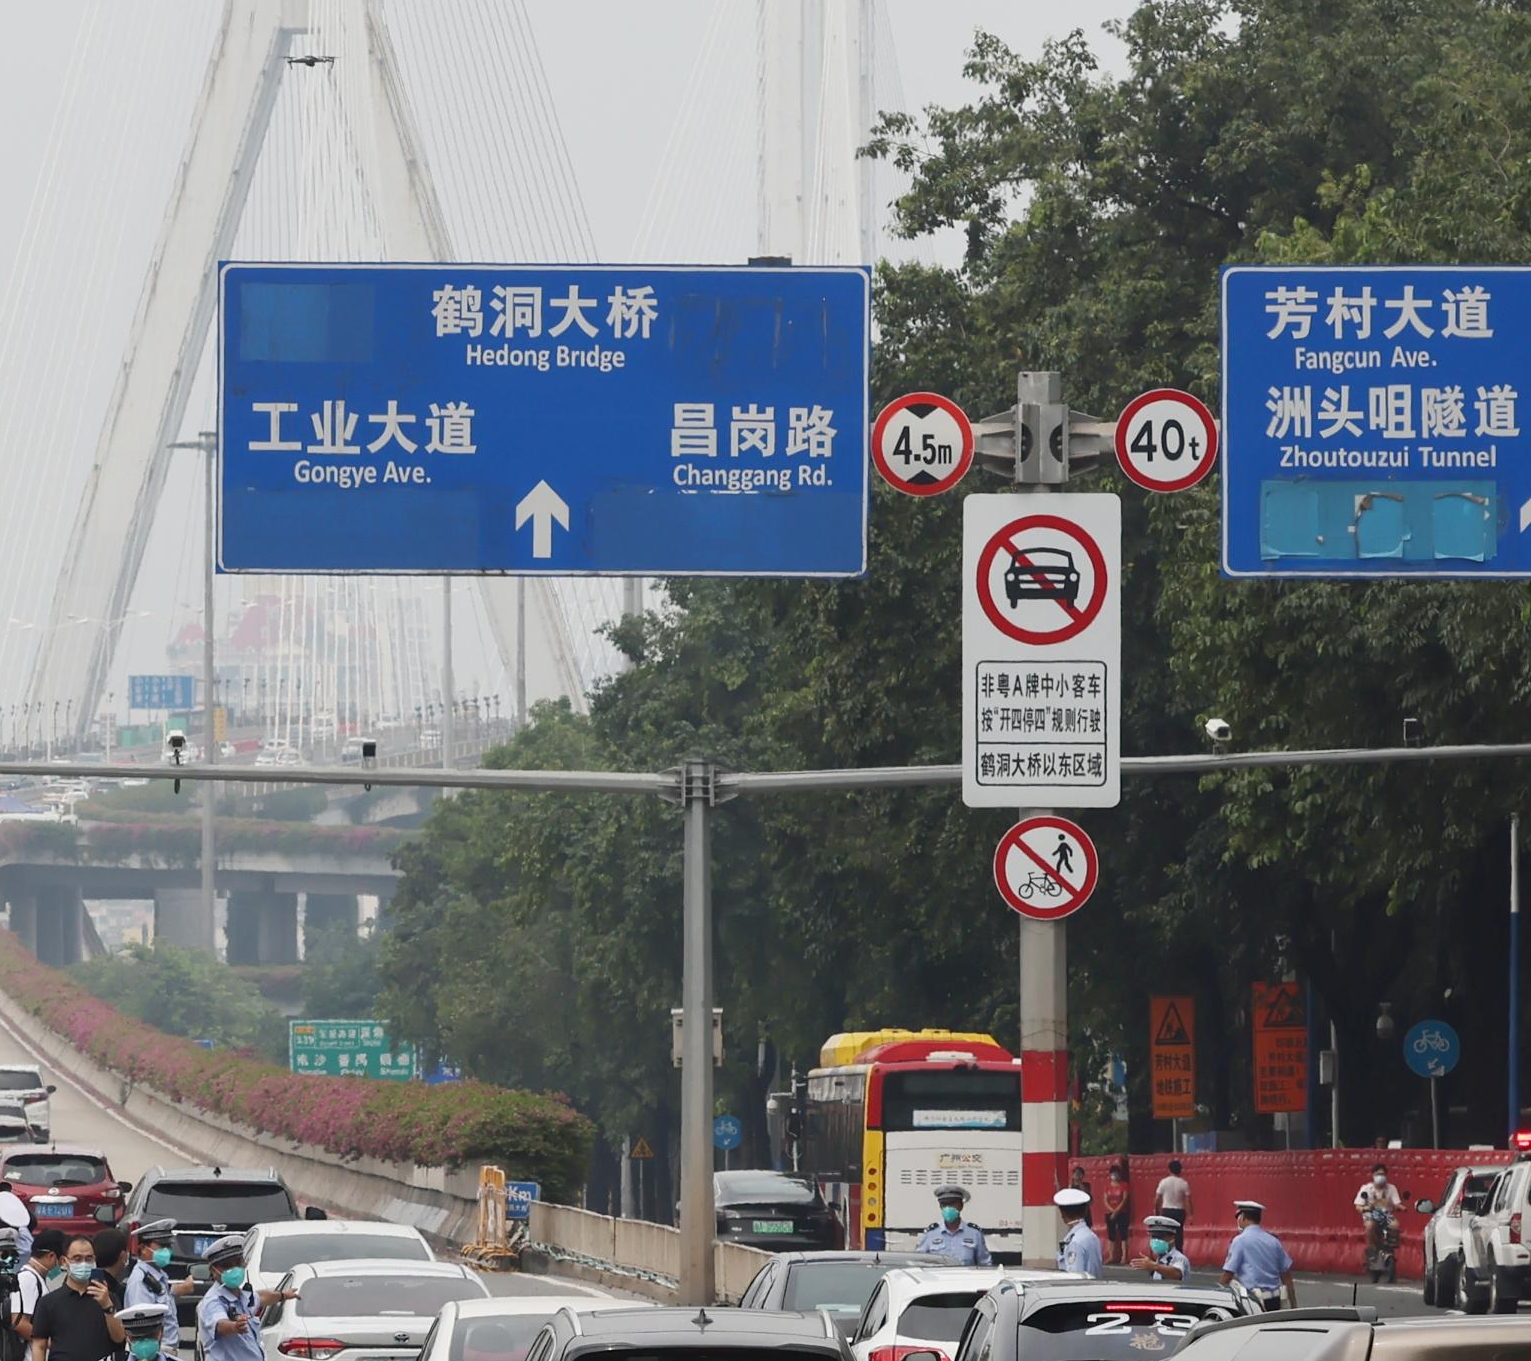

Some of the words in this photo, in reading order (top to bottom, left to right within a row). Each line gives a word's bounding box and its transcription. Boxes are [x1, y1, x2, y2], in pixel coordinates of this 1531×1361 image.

[432, 285, 659, 339] 鹤洞大桥
[1265, 286, 1494, 340] 芳村大道
[465, 345, 551, 371] Hedong
[556, 345, 626, 371] Bridge
[1294, 346, 1382, 374] Fangcun
[1391, 346, 1438, 369] Ave.
[248, 401, 477, 455] 工业大道
[1265, 384, 1521, 439] 洲头咀隧道
[670, 402, 837, 459] 昌岗路
[892, 426, 952, 465] 4.5m
[1130, 419, 1200, 462] 40t
[1279, 446, 1410, 469] Zhoutouzui
[1419, 446, 1498, 469] Tunnel
[294, 461, 380, 489] Gongye
[383, 461, 432, 484] Ave.
[673, 464, 790, 491] Changgang
[797, 464, 833, 487] Rd.
[980, 673, 1101, 699] 非粤A牌中小客车
[979, 751, 1103, 779] 鹤洞大桥以东区域
